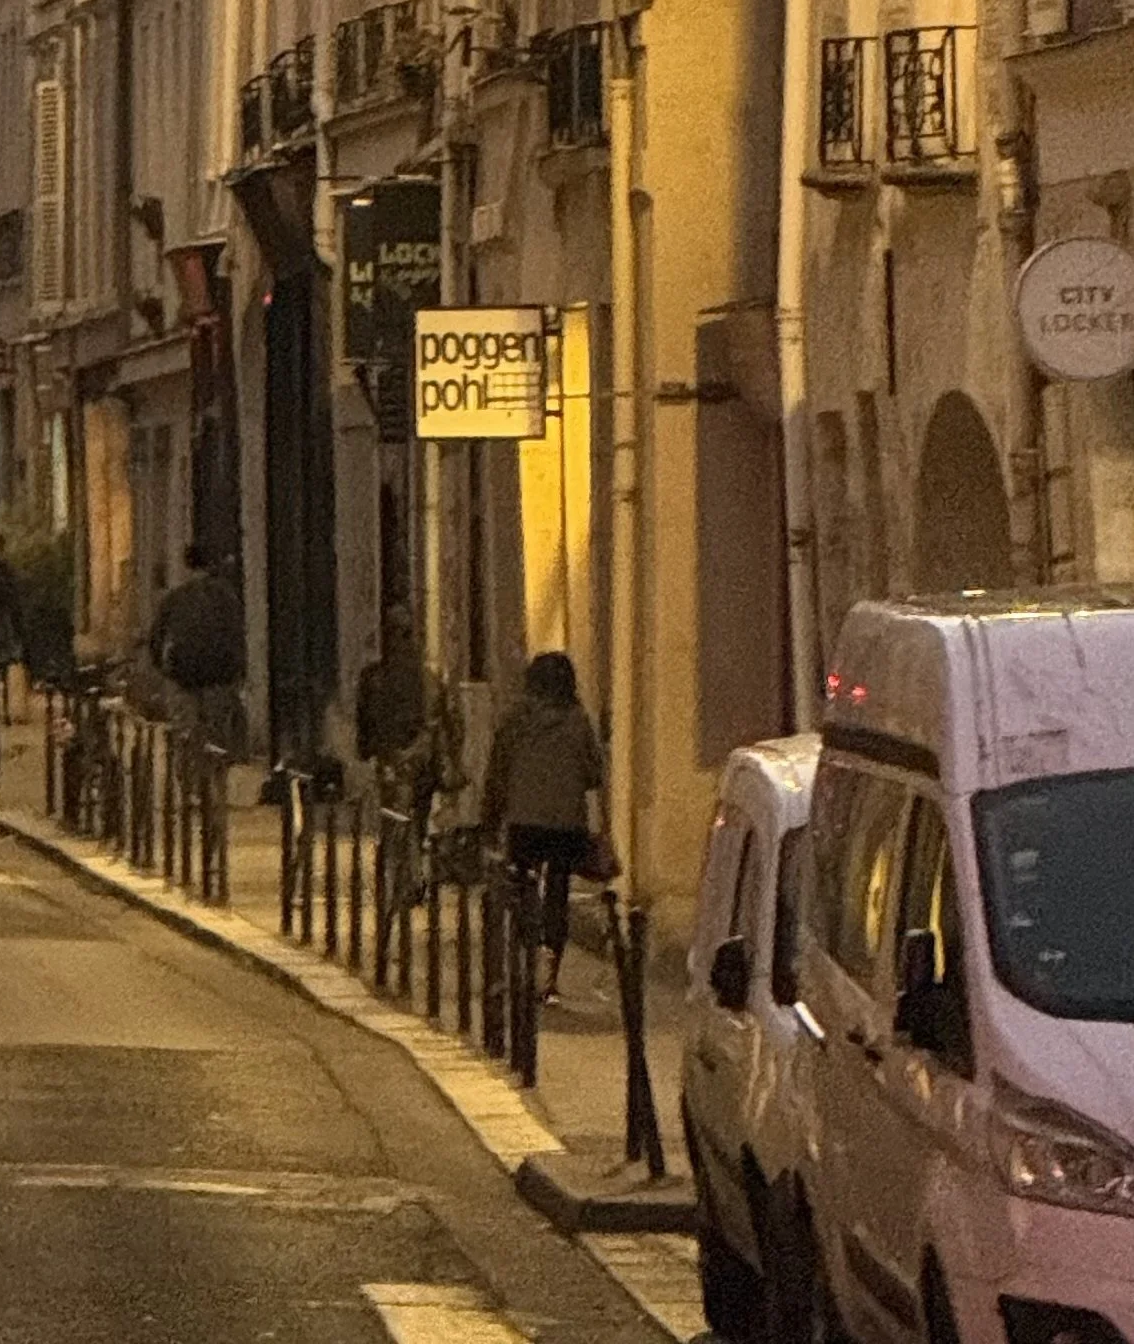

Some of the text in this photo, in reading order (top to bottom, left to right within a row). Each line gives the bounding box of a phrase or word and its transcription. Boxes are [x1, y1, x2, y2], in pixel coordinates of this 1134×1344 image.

[1059, 285, 1115, 305] CITY
[421, 332, 540, 370] poggen
[421, 373, 488, 417] pohl
